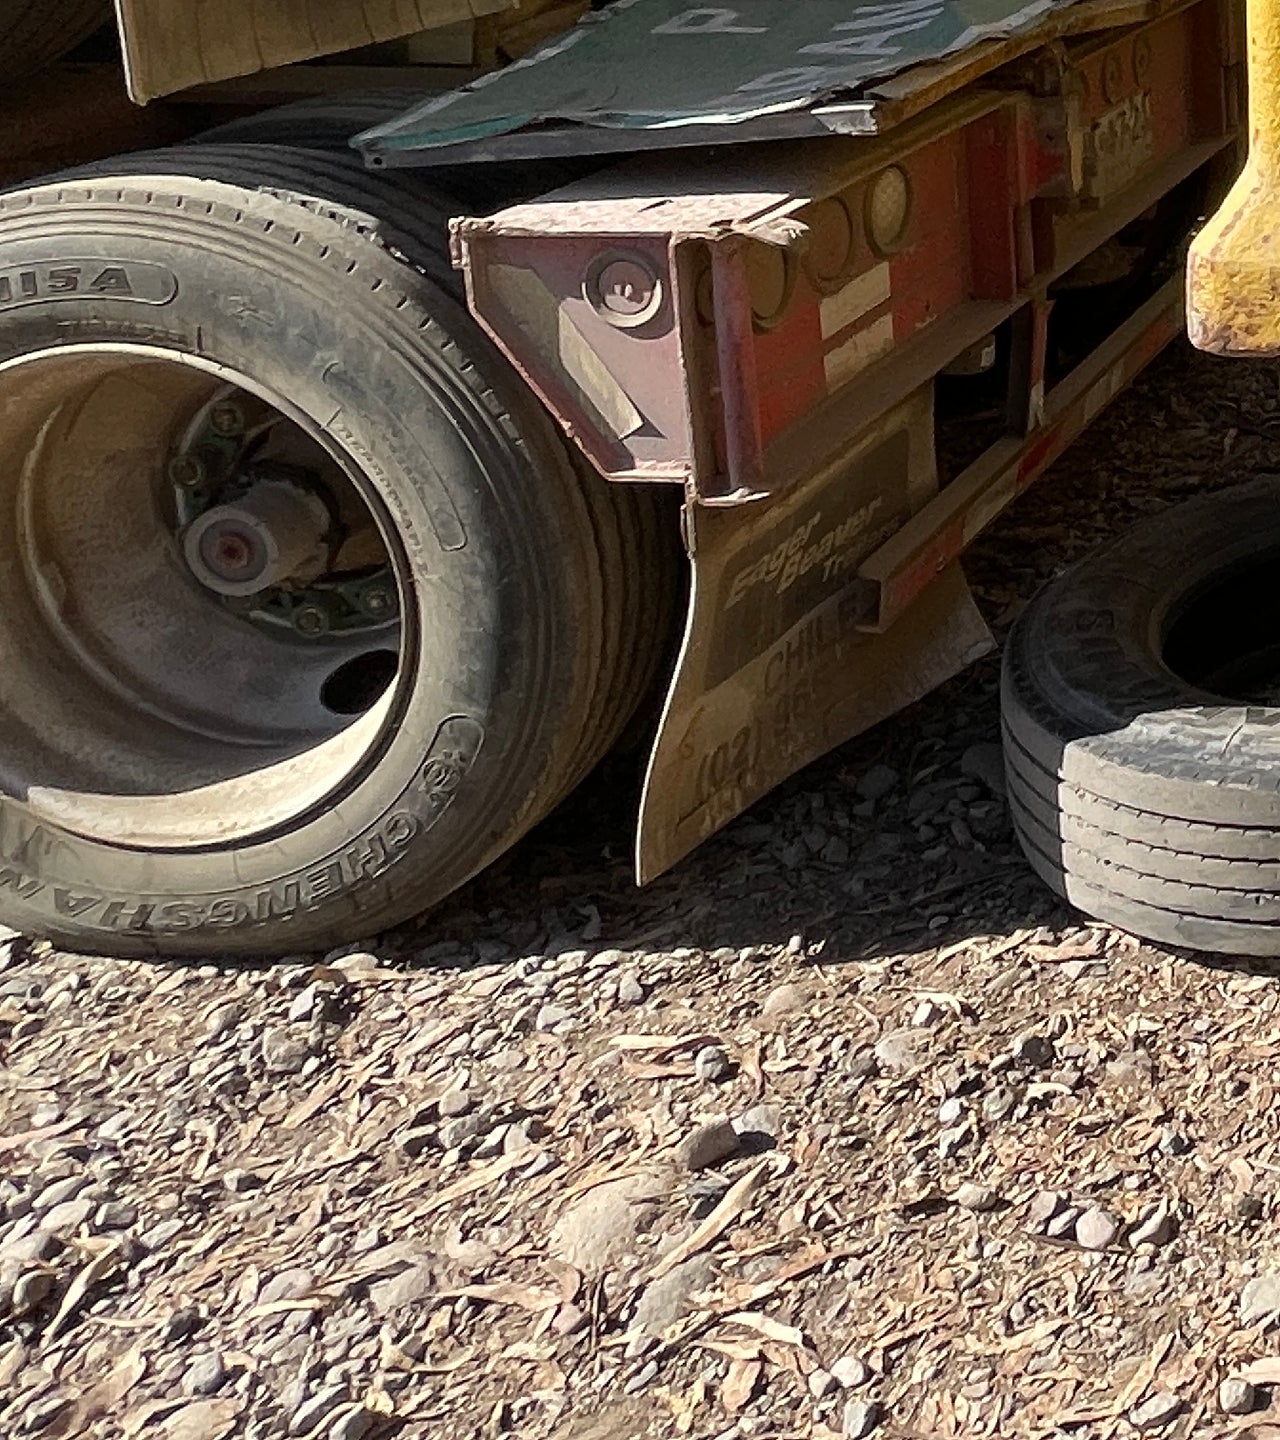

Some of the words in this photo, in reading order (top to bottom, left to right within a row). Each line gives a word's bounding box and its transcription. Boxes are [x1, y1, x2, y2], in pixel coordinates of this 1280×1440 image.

[722, 511, 822, 611] Eager
[776, 495, 882, 595] Beaver
[0, 810, 425, 929] CHENGSHAN
